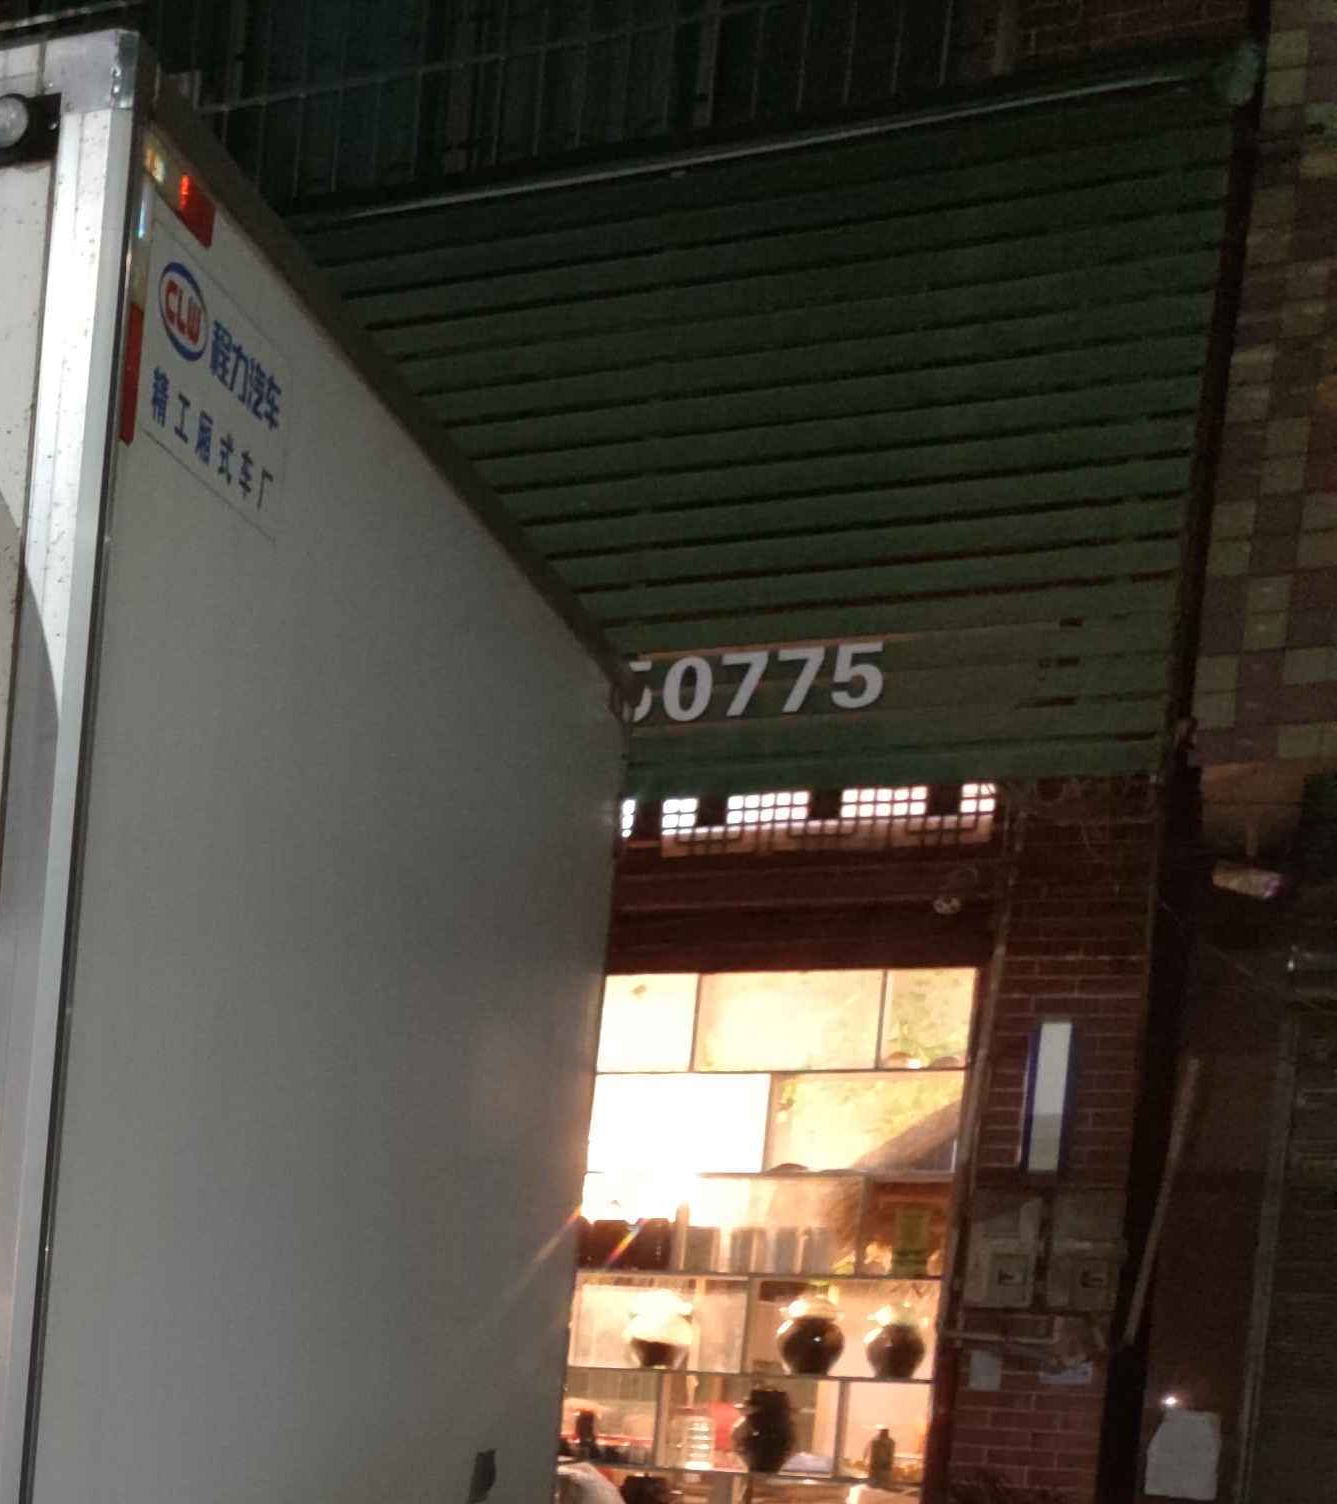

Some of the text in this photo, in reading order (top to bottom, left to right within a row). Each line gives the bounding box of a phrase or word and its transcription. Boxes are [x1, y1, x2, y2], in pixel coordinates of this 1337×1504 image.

[151, 365, 274, 511] 精工厢式车厂
[210, 319, 282, 432] 程力汽车
